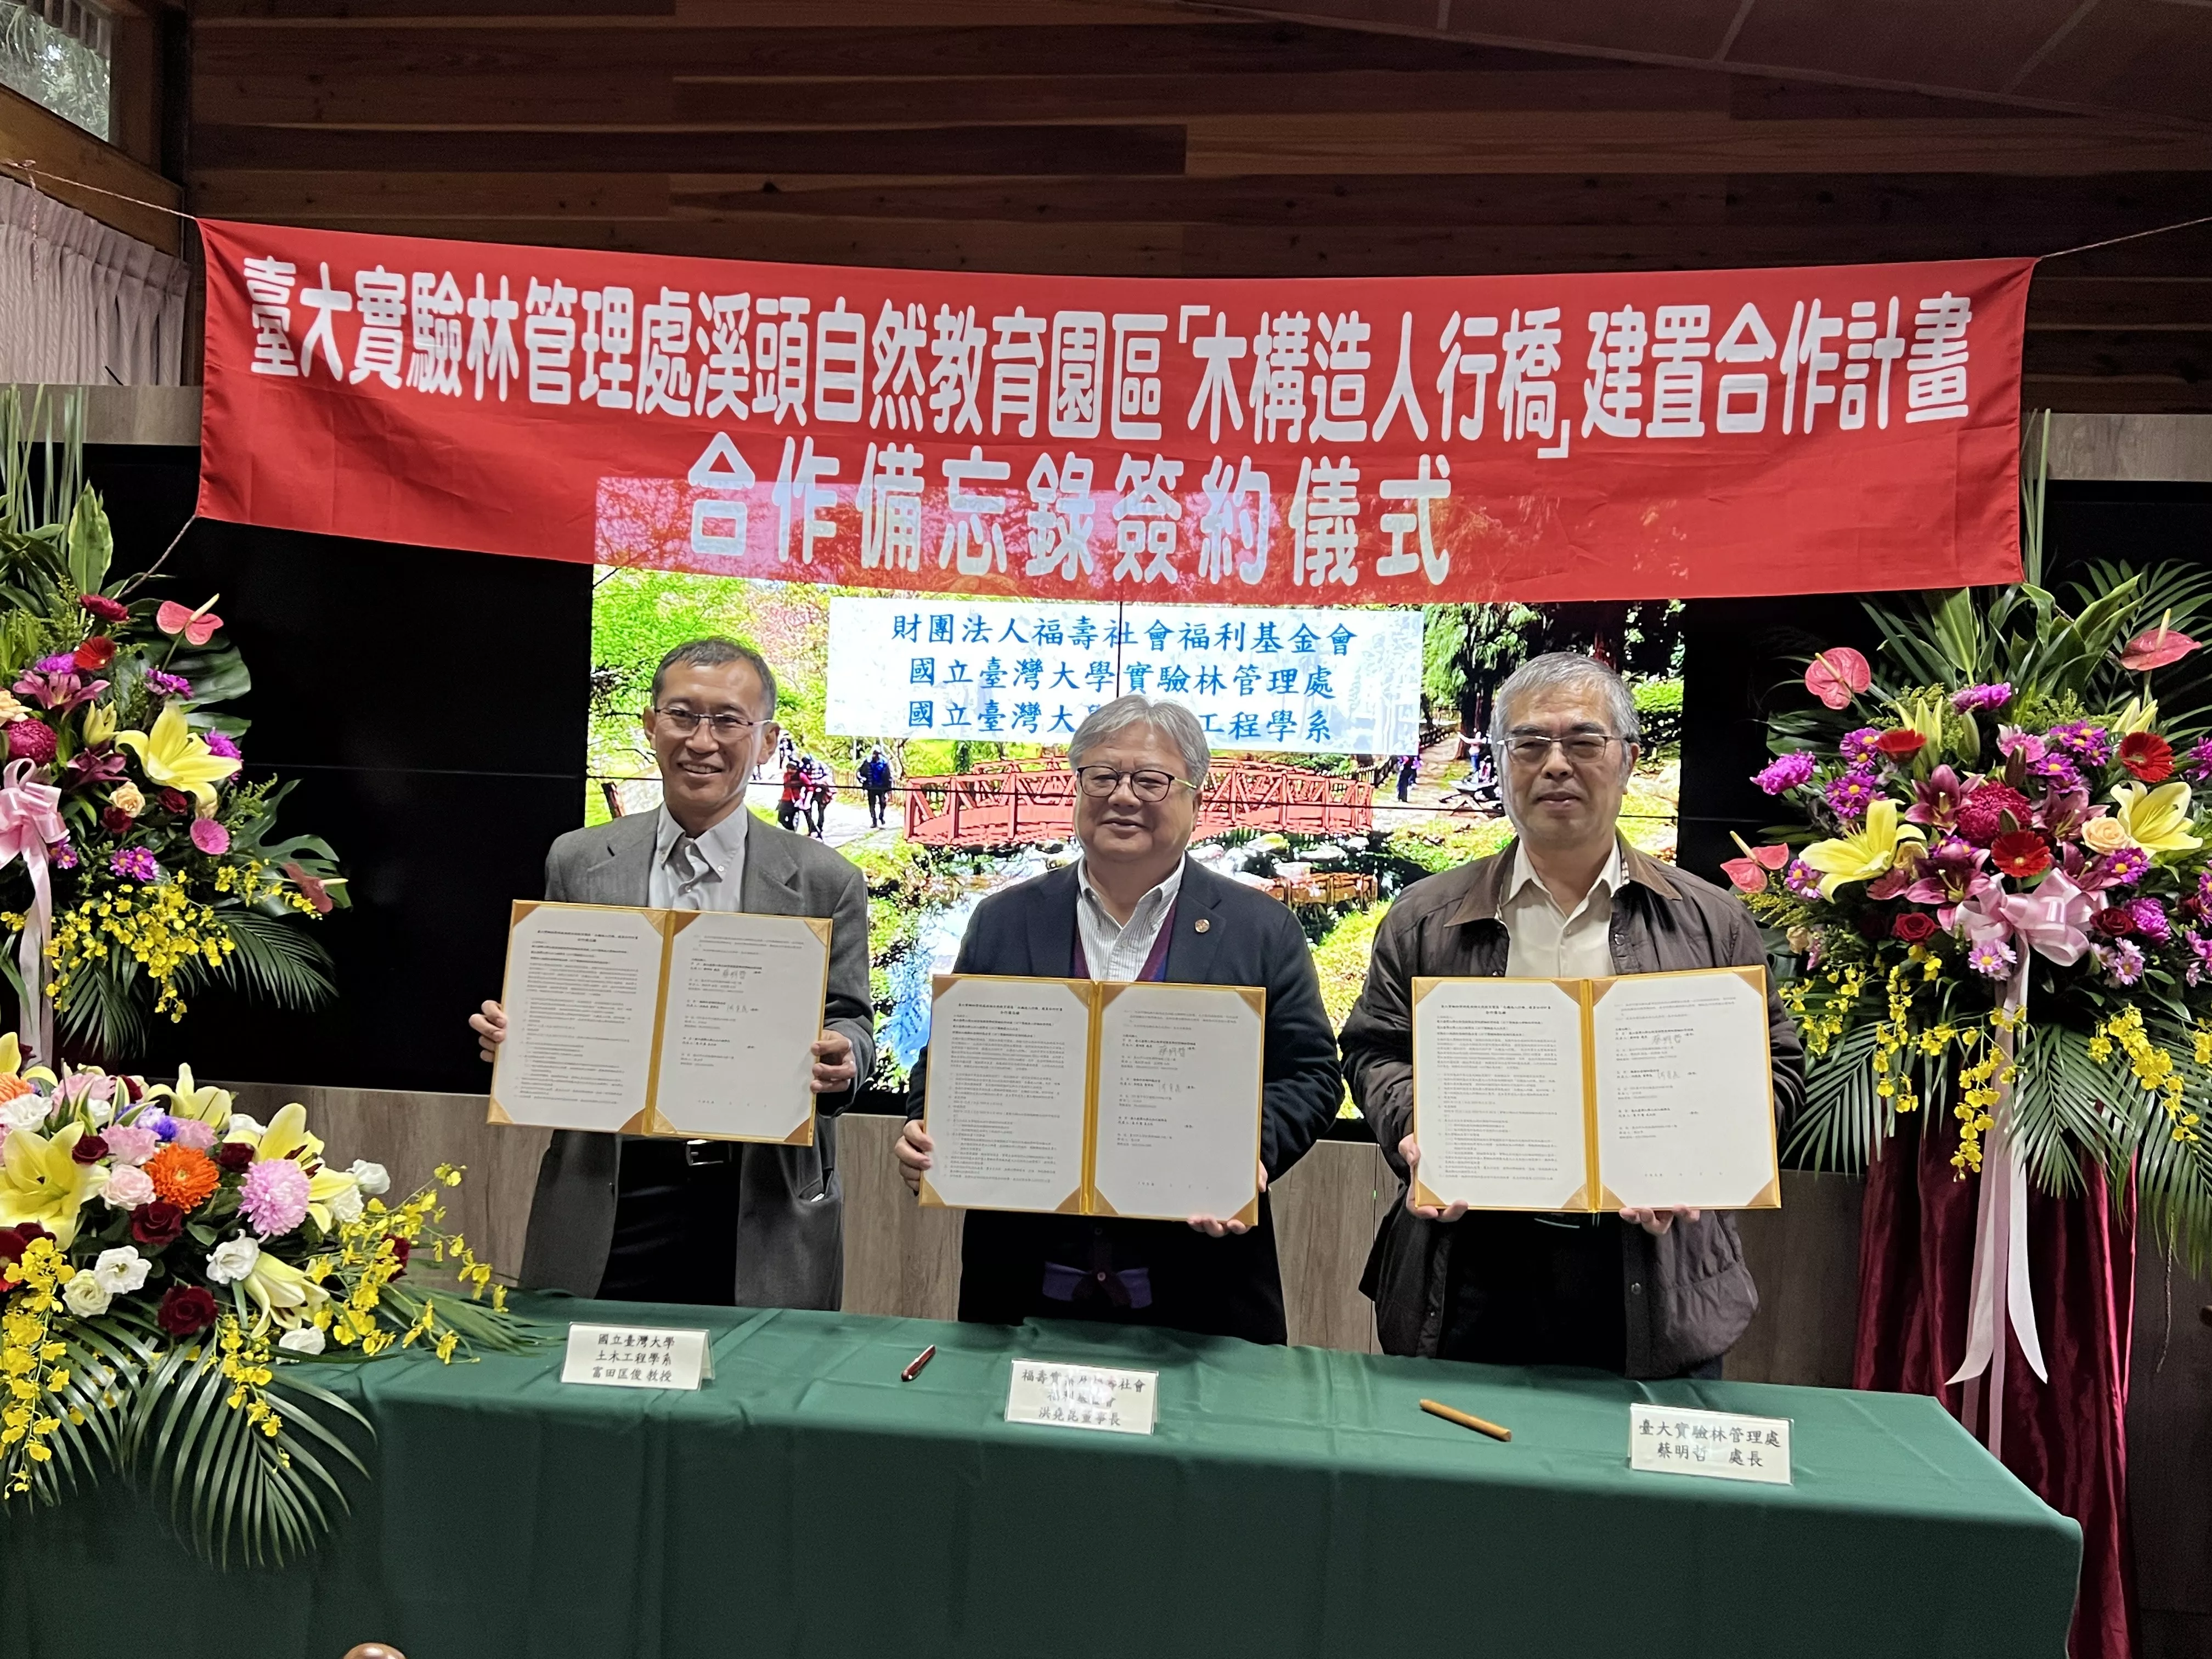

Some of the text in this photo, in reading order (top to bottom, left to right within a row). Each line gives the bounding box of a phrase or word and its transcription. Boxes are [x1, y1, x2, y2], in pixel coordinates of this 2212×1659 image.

[687, 431, 1451, 586] 合作備忘錄簽約儀式
[893, 613, 1357, 656] 財團法人福壽社會福利基金會
[911, 656, 1337, 700] 國立臺灣大學實驗林管理處
[908, 700, 1331, 743] 國立臺灣大工程學系
[595, 1350, 672, 1366] 土木工程學系
[598, 1334, 675, 1350] 國立臺灣大學
[1639, 1418, 1781, 1448] 臺大實驗林管理處
[1729, 1447, 1764, 1468] 處長
